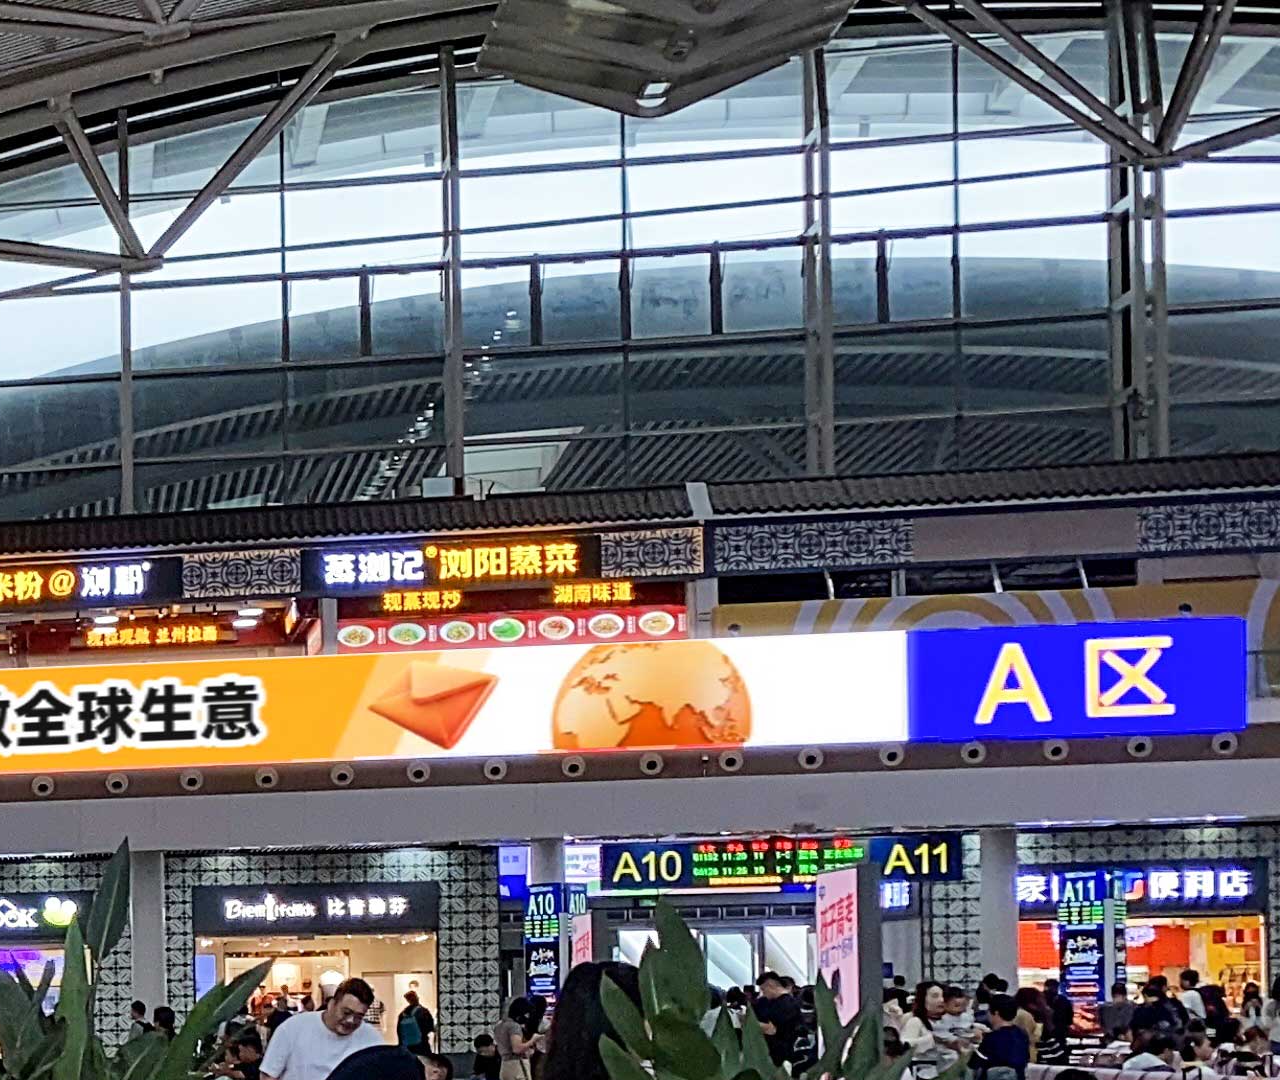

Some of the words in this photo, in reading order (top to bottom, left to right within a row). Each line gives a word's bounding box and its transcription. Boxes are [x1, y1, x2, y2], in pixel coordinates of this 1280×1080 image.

[440, 542, 579, 580] 浏阳蒸菜
[383, 589, 462, 612] 现蒸现炒
[553, 582, 635, 605] 湖南味道
[613, 849, 683, 883] A10
[883, 842, 948, 876] A11
[1064, 879, 1096, 902] A11
[1150, 869, 1252, 899] 便利店
[528, 893, 555, 915] A10
[569, 893, 586, 914] A10
